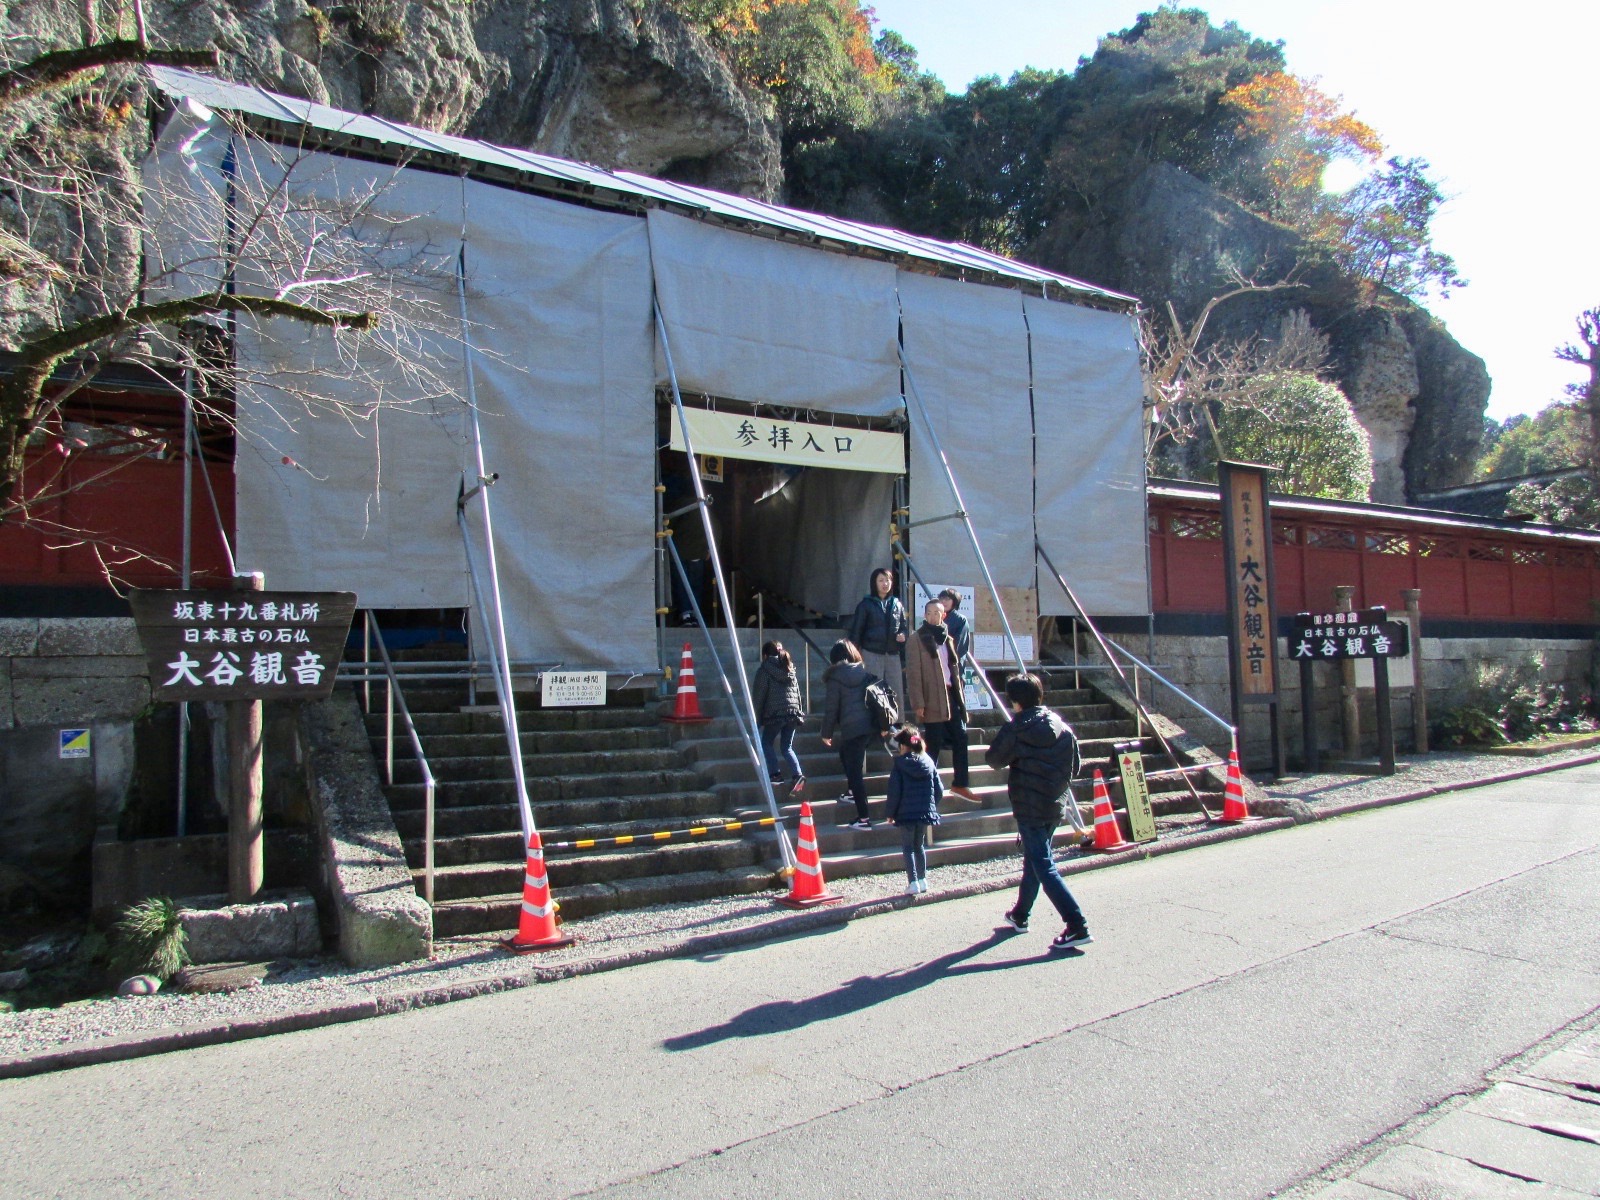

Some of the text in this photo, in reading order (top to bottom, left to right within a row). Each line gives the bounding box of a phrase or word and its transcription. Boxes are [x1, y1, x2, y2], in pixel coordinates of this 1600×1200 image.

[735, 419, 853, 454] 参拝入口
[173, 601, 320, 622] 坂東十九番札所
[1240, 554, 1265, 674] 大谷観音
[184, 628, 310, 643] 日本最古の石仏
[1304, 625, 1381, 638] 日本最古の石仏
[1295, 635, 1391, 657] 大谷観音
[162, 650, 326, 686] 大谷観音
